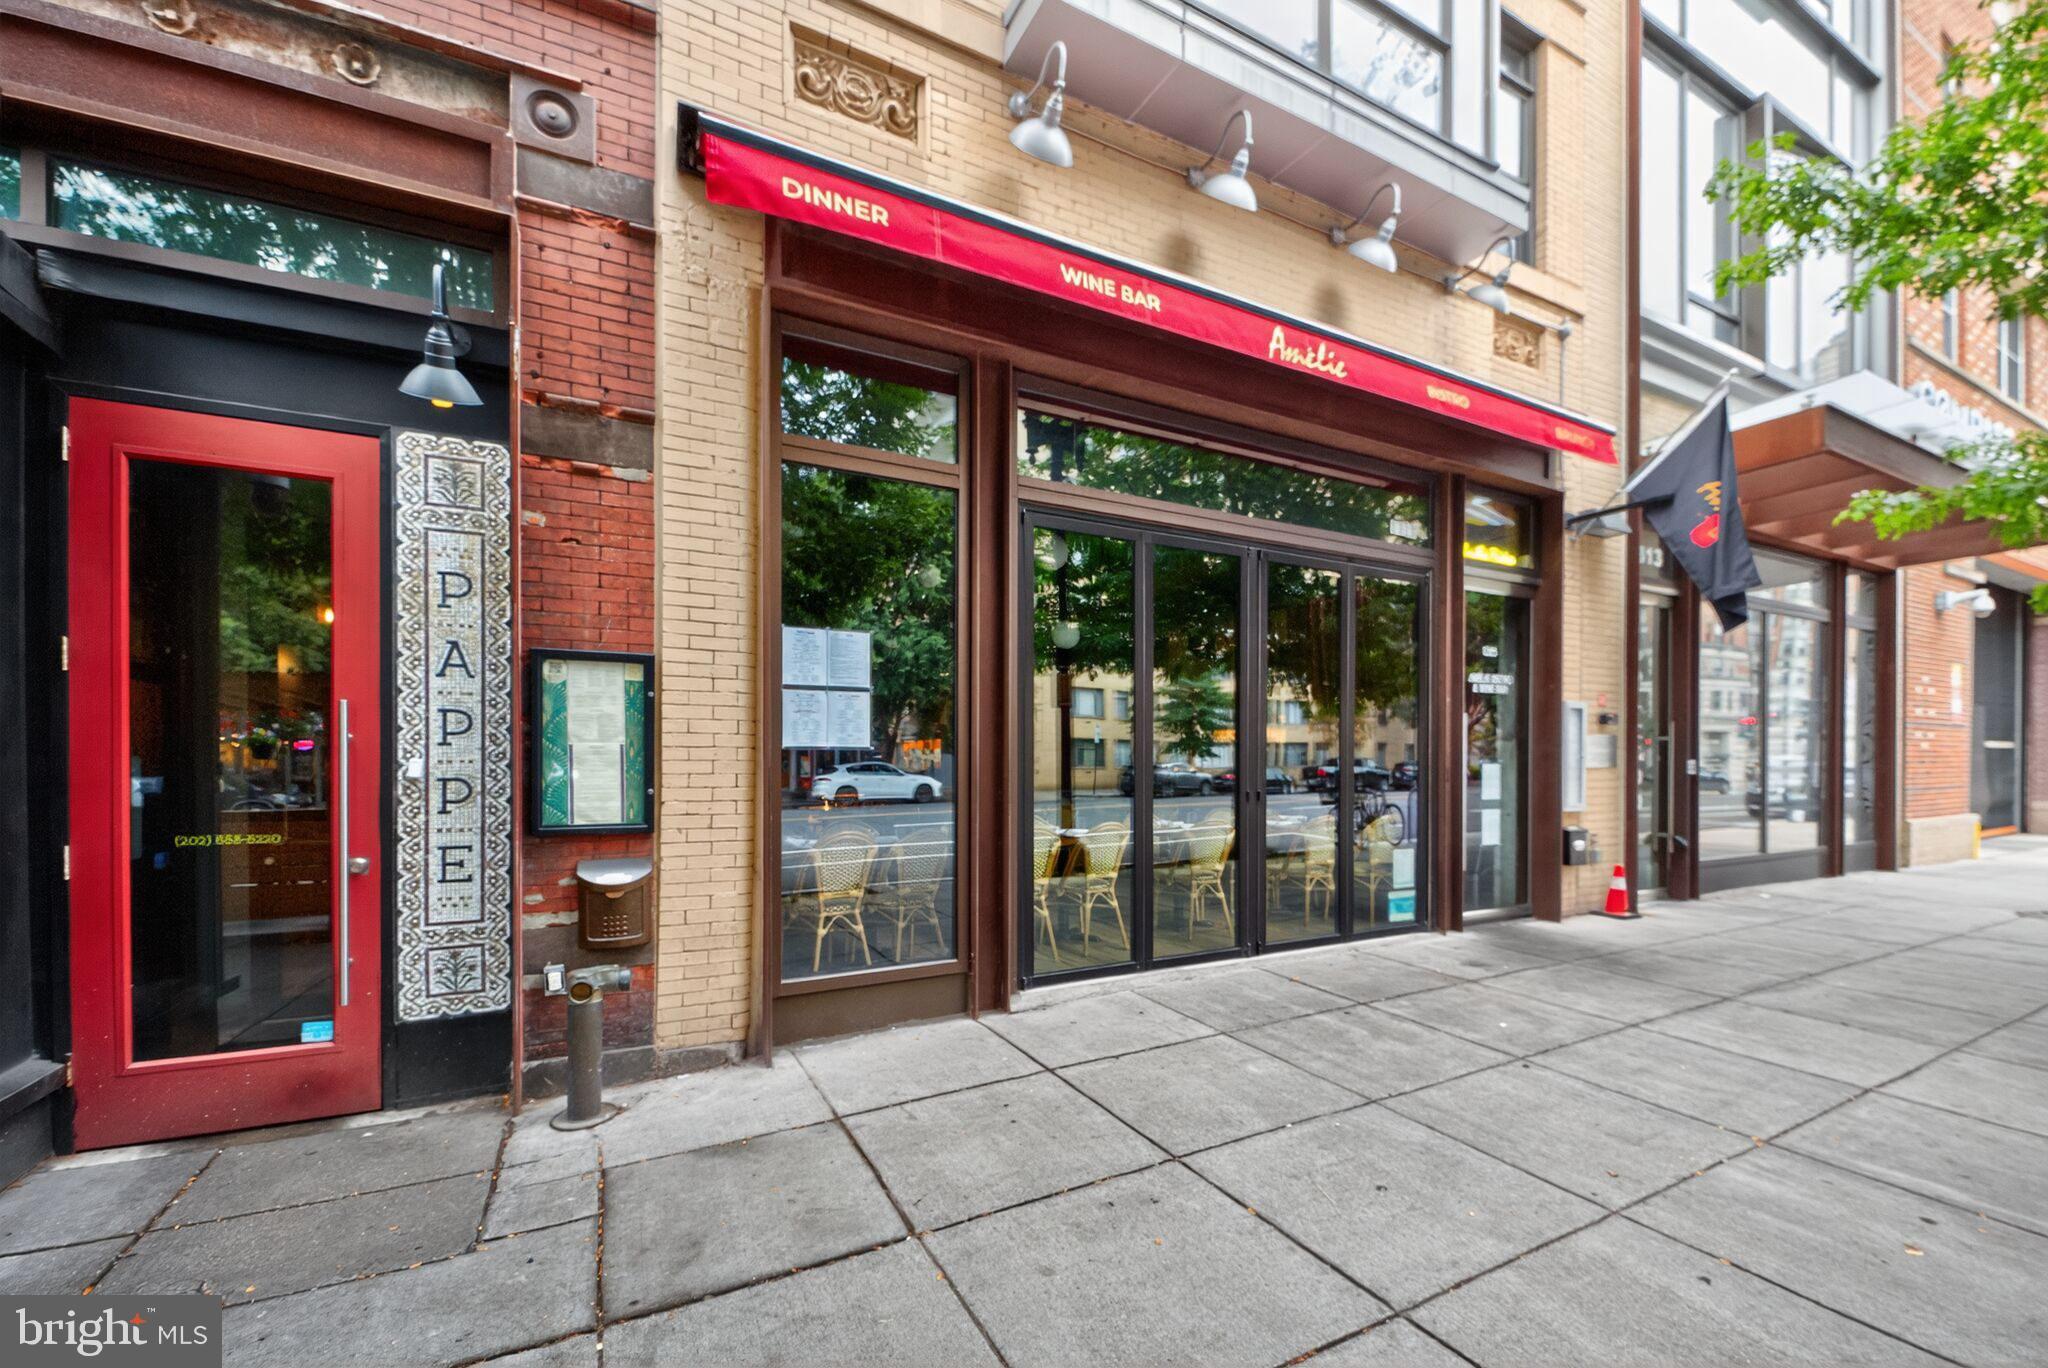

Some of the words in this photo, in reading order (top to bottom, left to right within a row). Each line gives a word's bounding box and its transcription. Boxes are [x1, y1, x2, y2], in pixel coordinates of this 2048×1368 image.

[782, 175, 889, 227] DINNER
[1060, 262, 1117, 298] WINE
[1121, 284, 1161, 312] BAR
[435, 571, 475, 884] PAPPE
